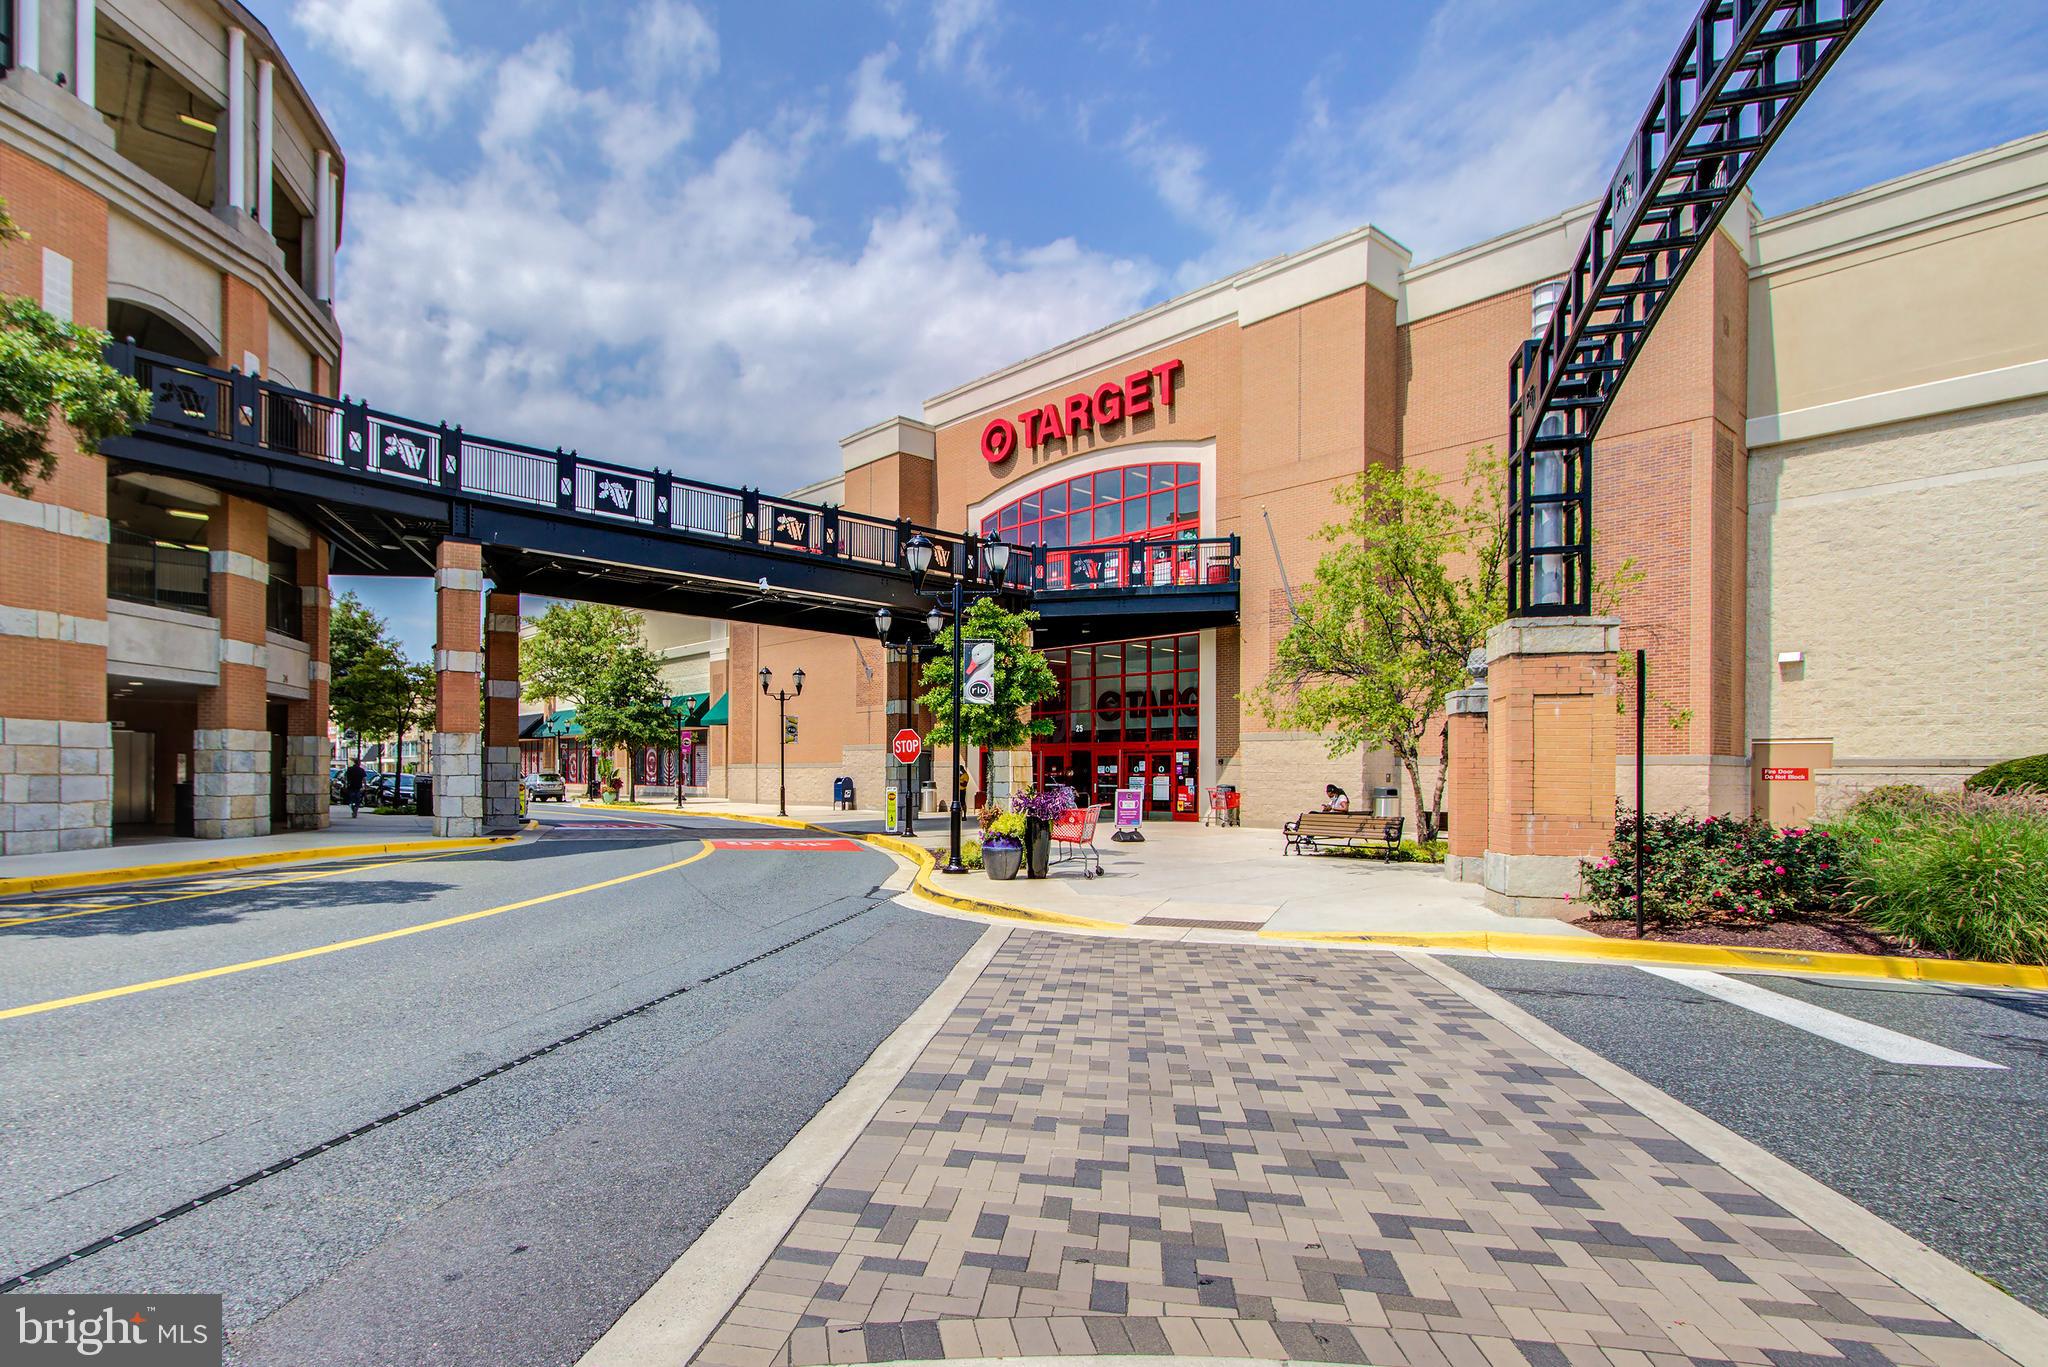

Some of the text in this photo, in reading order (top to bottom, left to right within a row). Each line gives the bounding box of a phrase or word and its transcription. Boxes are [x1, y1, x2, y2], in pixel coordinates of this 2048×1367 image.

[1018, 359, 1183, 449] TARGET
[971, 686, 987, 695] rio
[1075, 724, 1084, 733] 25
[895, 739, 919, 754] STOP
